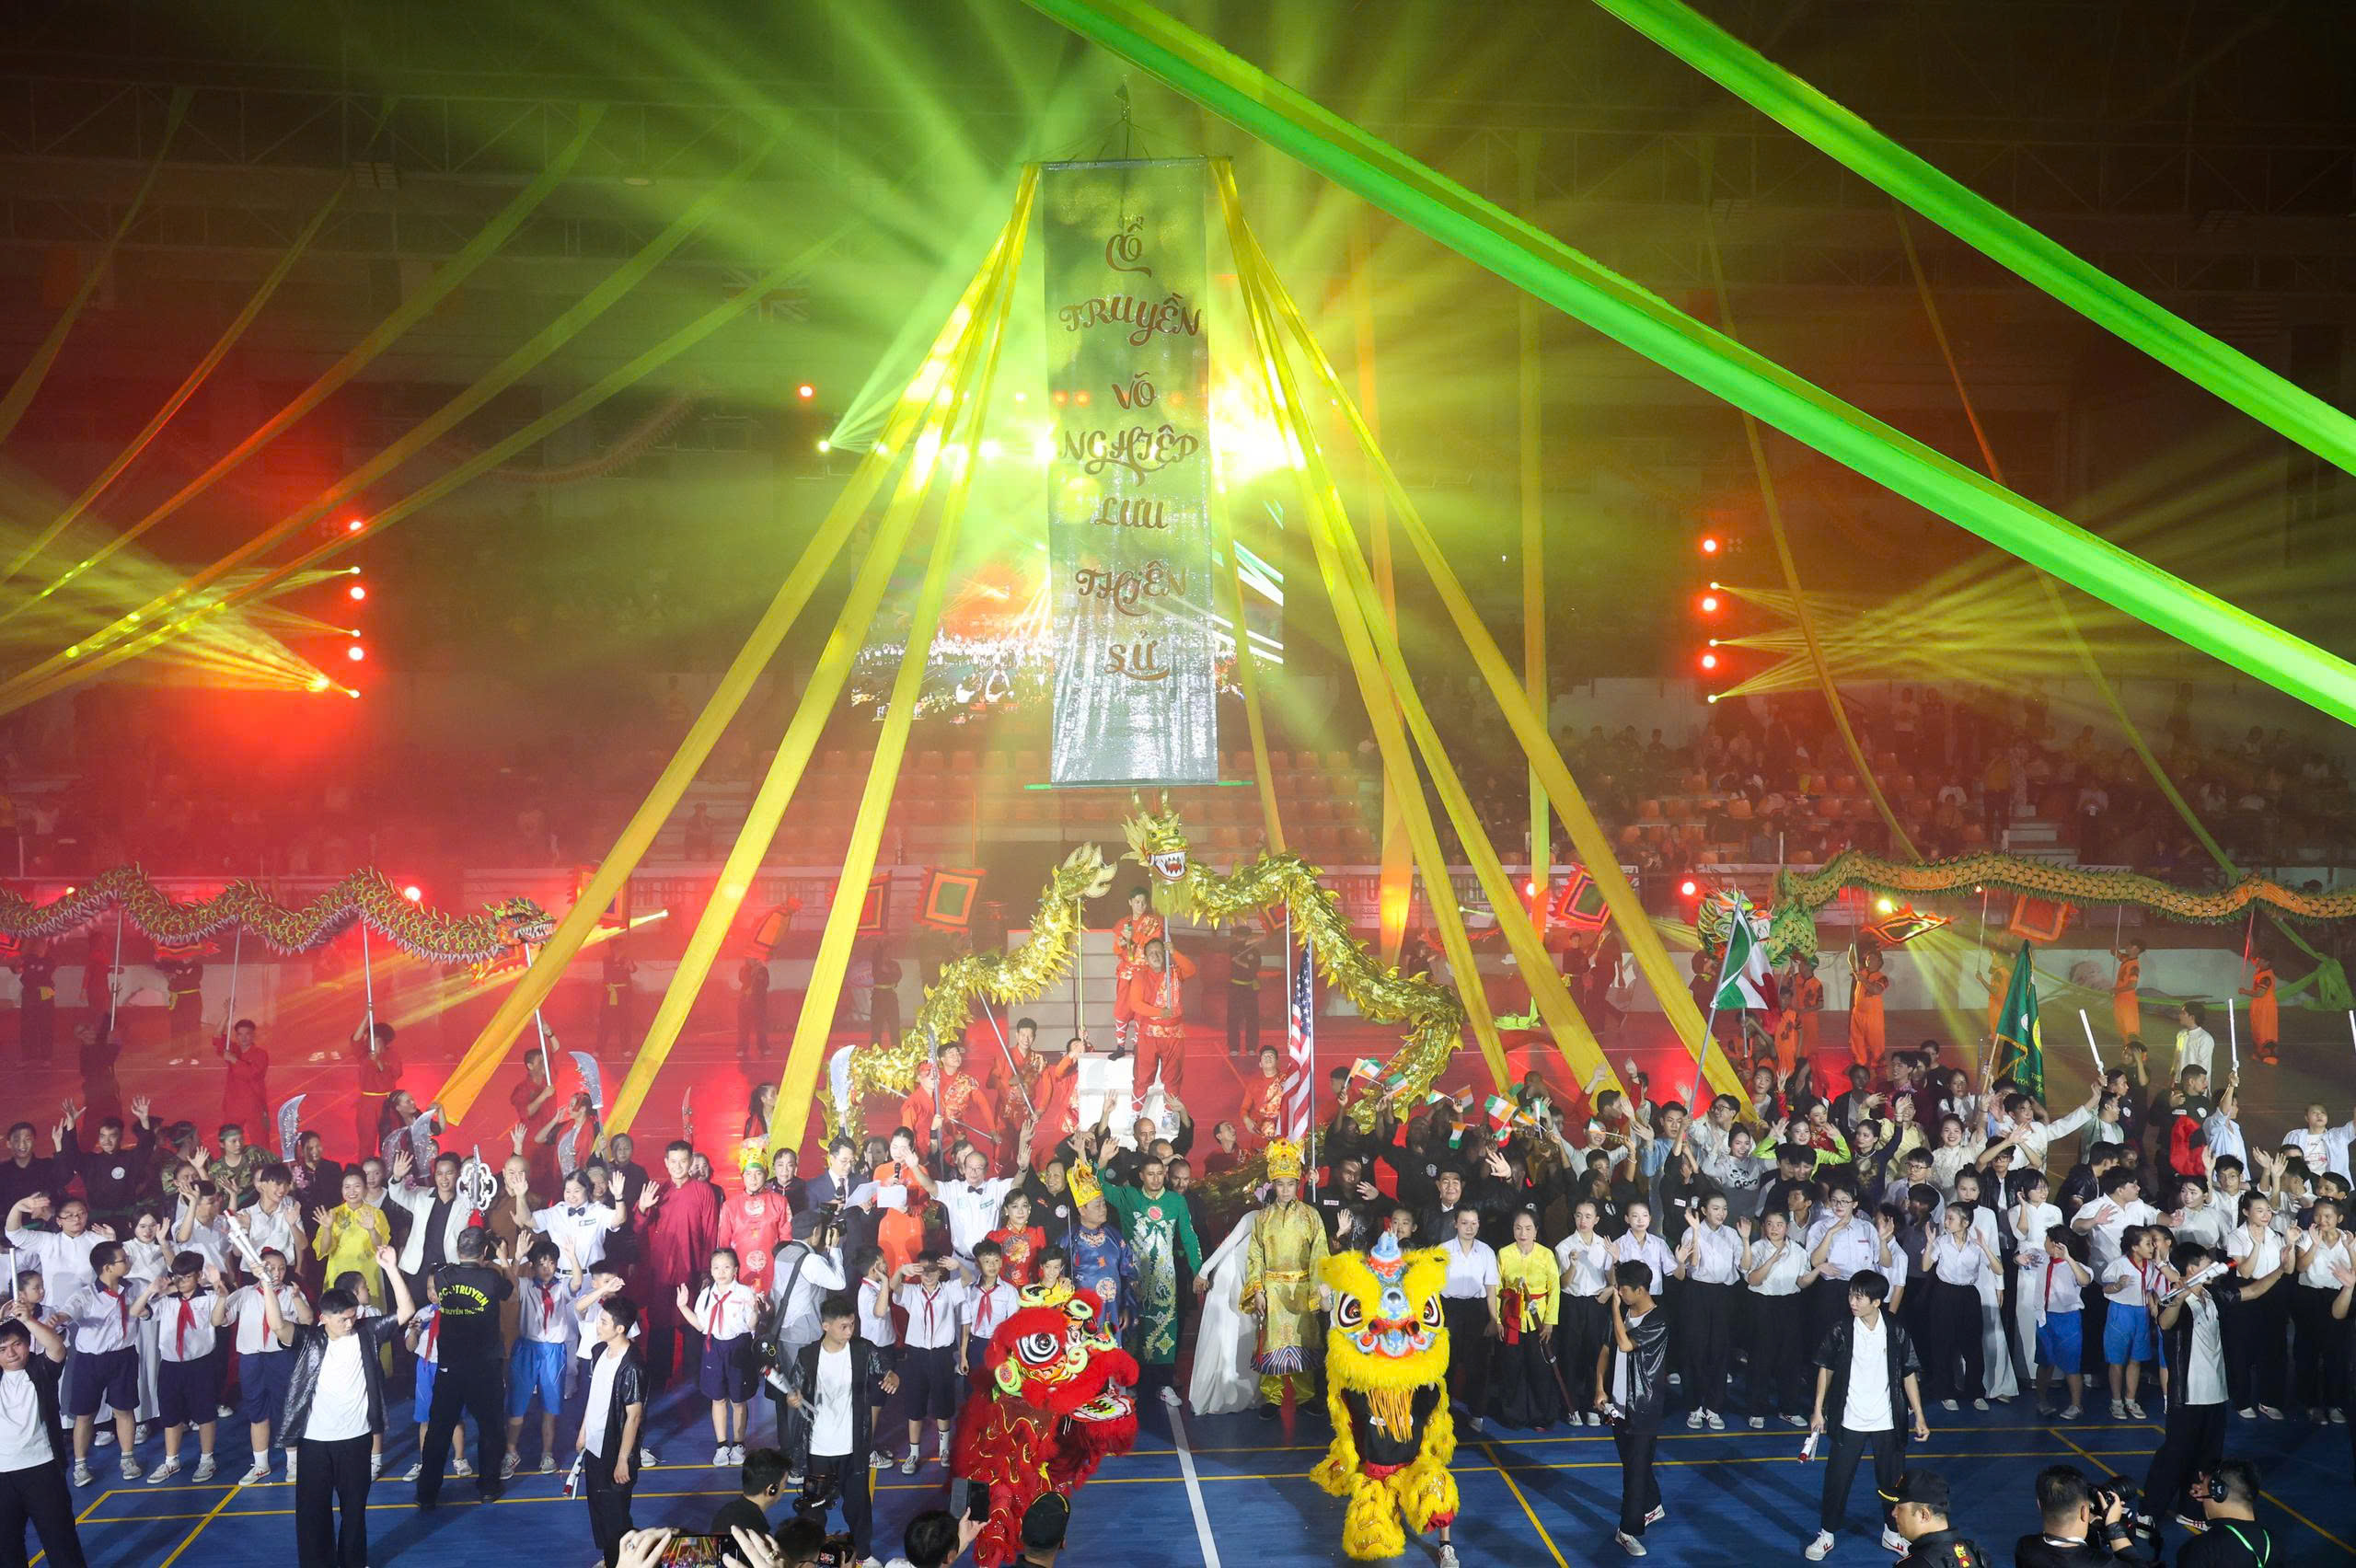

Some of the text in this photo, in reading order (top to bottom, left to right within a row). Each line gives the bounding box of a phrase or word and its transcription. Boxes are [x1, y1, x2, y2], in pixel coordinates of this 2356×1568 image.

[1105, 215, 1152, 278] CỔ
[1058, 292, 1201, 347] TRUYỀN
[1111, 371, 1157, 409] VÕ
[1093, 497, 1169, 529] LƯU
[1075, 559, 1187, 617] THIÊN
[1104, 629, 1171, 681] SỬ
